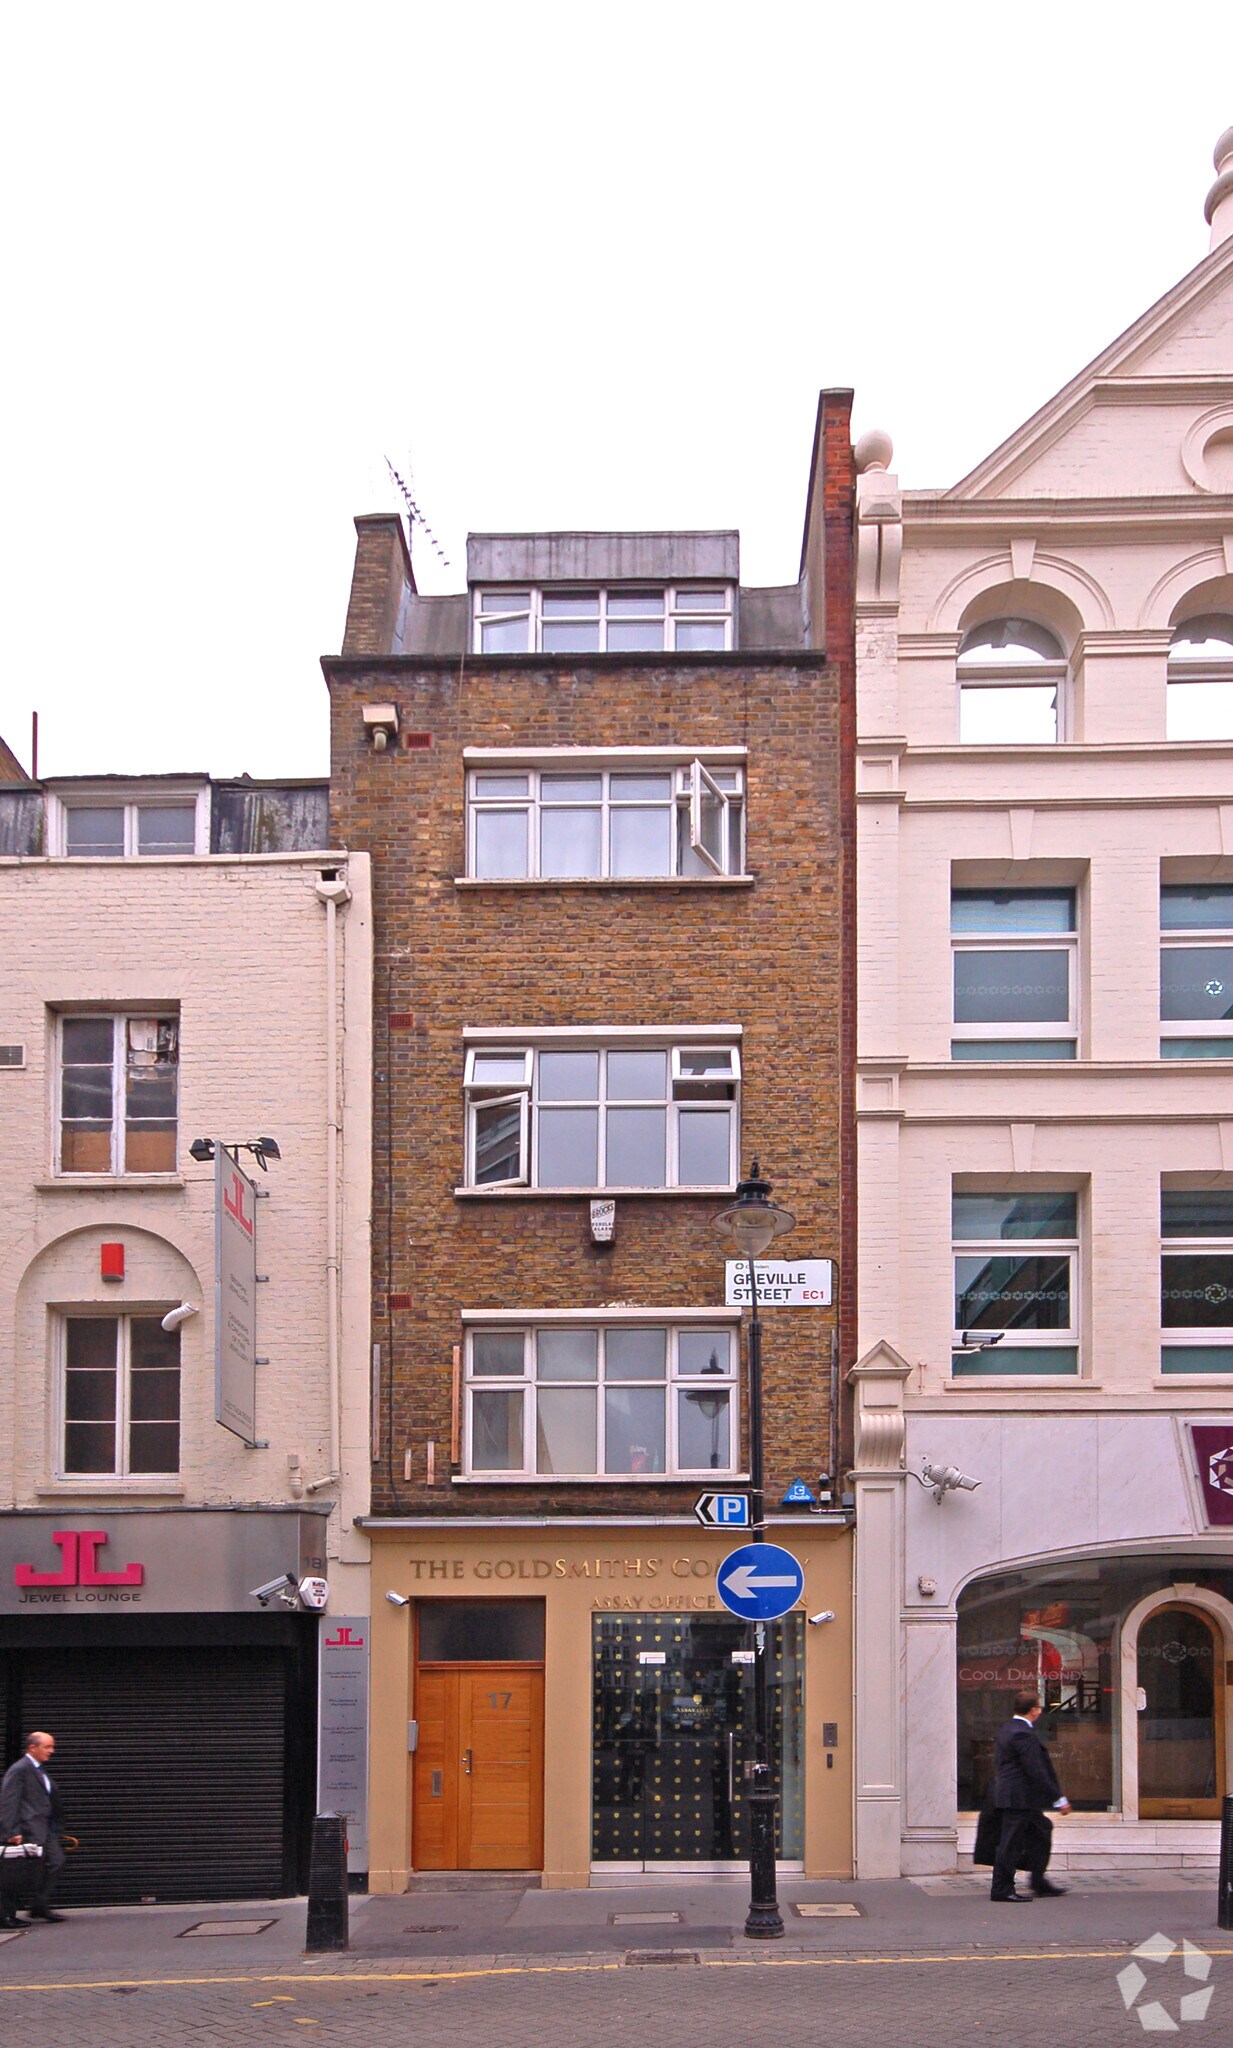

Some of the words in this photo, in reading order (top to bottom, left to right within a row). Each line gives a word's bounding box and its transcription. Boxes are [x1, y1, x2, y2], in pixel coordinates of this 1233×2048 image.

[733, 1289, 792, 1300] STREET
[803, 1291, 824, 1299] EC1
[723, 1499, 741, 1521] P
[15, 1531, 144, 1587] JL
[409, 1560, 465, 1579] THE
[473, 1558, 663, 1579] GOLDSMITHS'
[19, 1594, 70, 1603] JEWEL
[75, 1593, 142, 1602] LOUNGE
[591, 1595, 644, 1609] ASSAY
[649, 1595, 716, 1609] OFFICE
[959, 1668, 1002, 1681] COOL
[1007, 1668, 1088, 1681] DIAMONDS
[487, 1692, 512, 1709] 17
